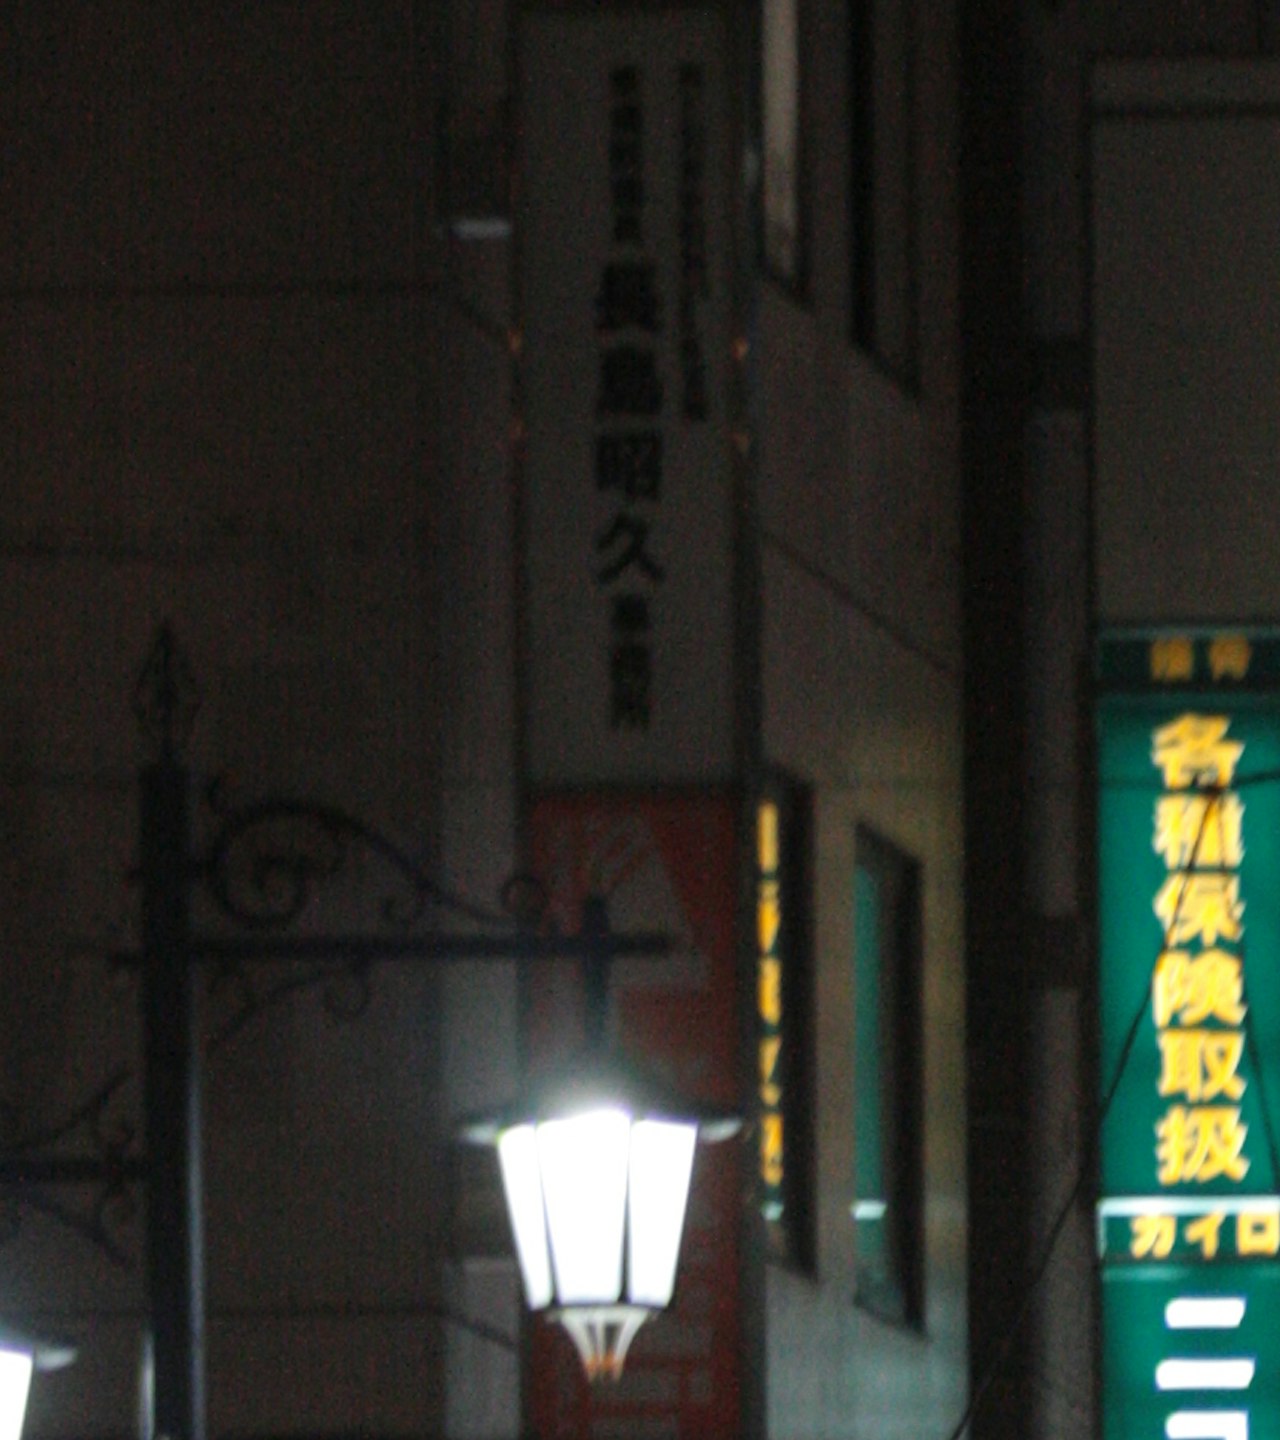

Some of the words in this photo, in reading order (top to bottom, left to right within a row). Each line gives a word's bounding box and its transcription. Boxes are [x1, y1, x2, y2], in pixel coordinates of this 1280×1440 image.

[1152, 713, 1250, 1186] 各種保険取扱
